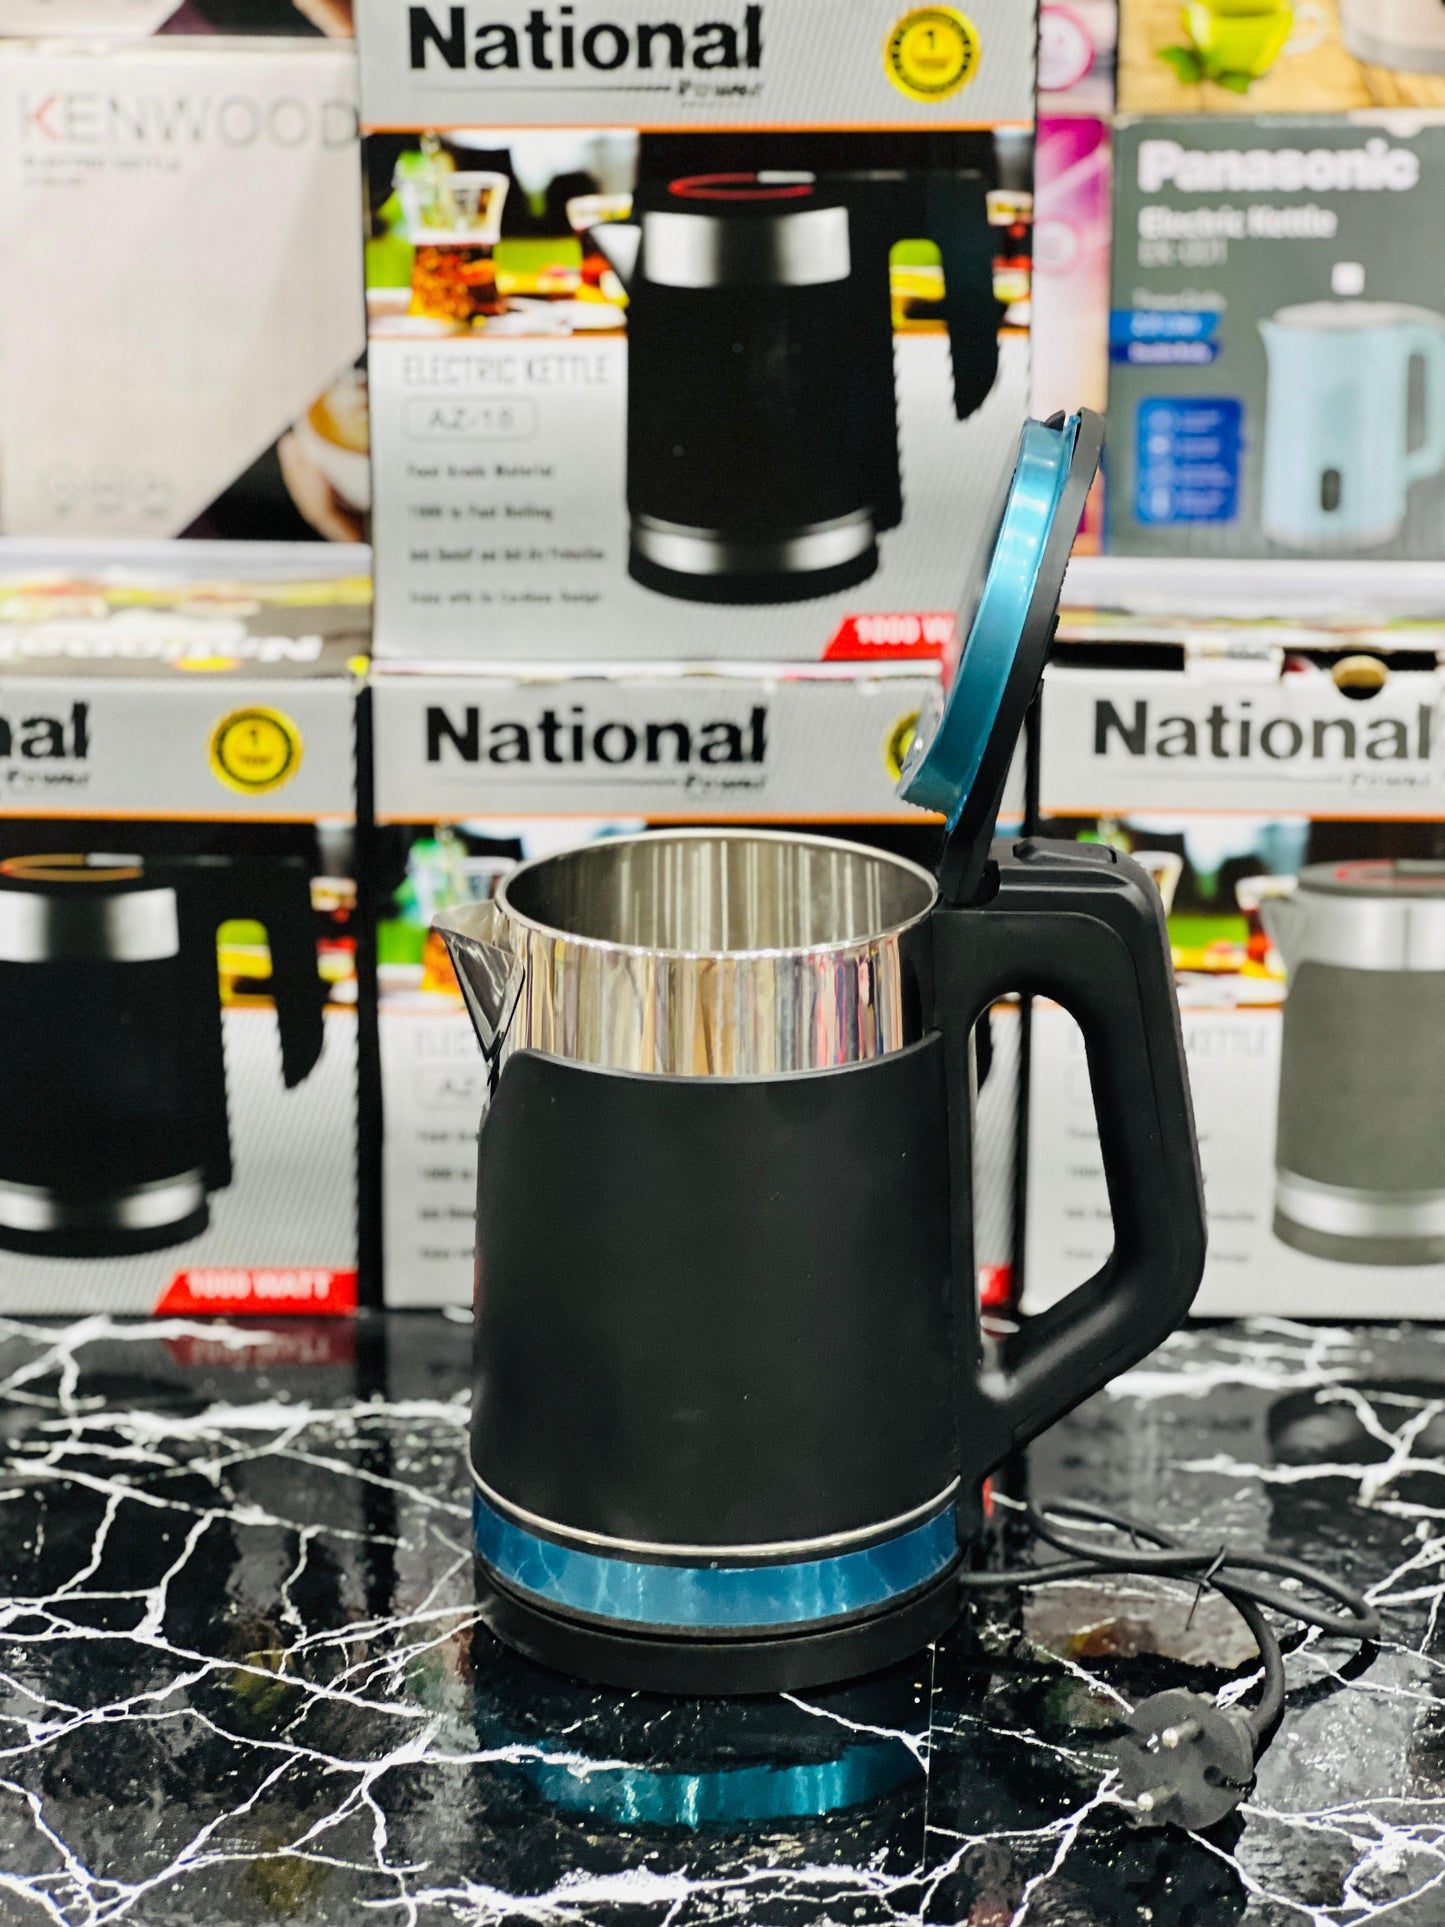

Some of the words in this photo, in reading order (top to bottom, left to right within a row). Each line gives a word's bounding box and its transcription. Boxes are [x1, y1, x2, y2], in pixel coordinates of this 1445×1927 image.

[409, 5, 764, 70] National
[20, 90, 359, 150] KENWOOD
[1137, 138, 1421, 192] Panasonic
[1138, 205, 1245, 240] Electric
[1247, 204, 1338, 240] Kettle
[404, 355, 518, 387] ELECTRIC
[525, 355, 609, 386] KETTLE
[0, 702, 90, 760] al
[426, 706, 768, 764] National
[1094, 700, 1433, 760] National
